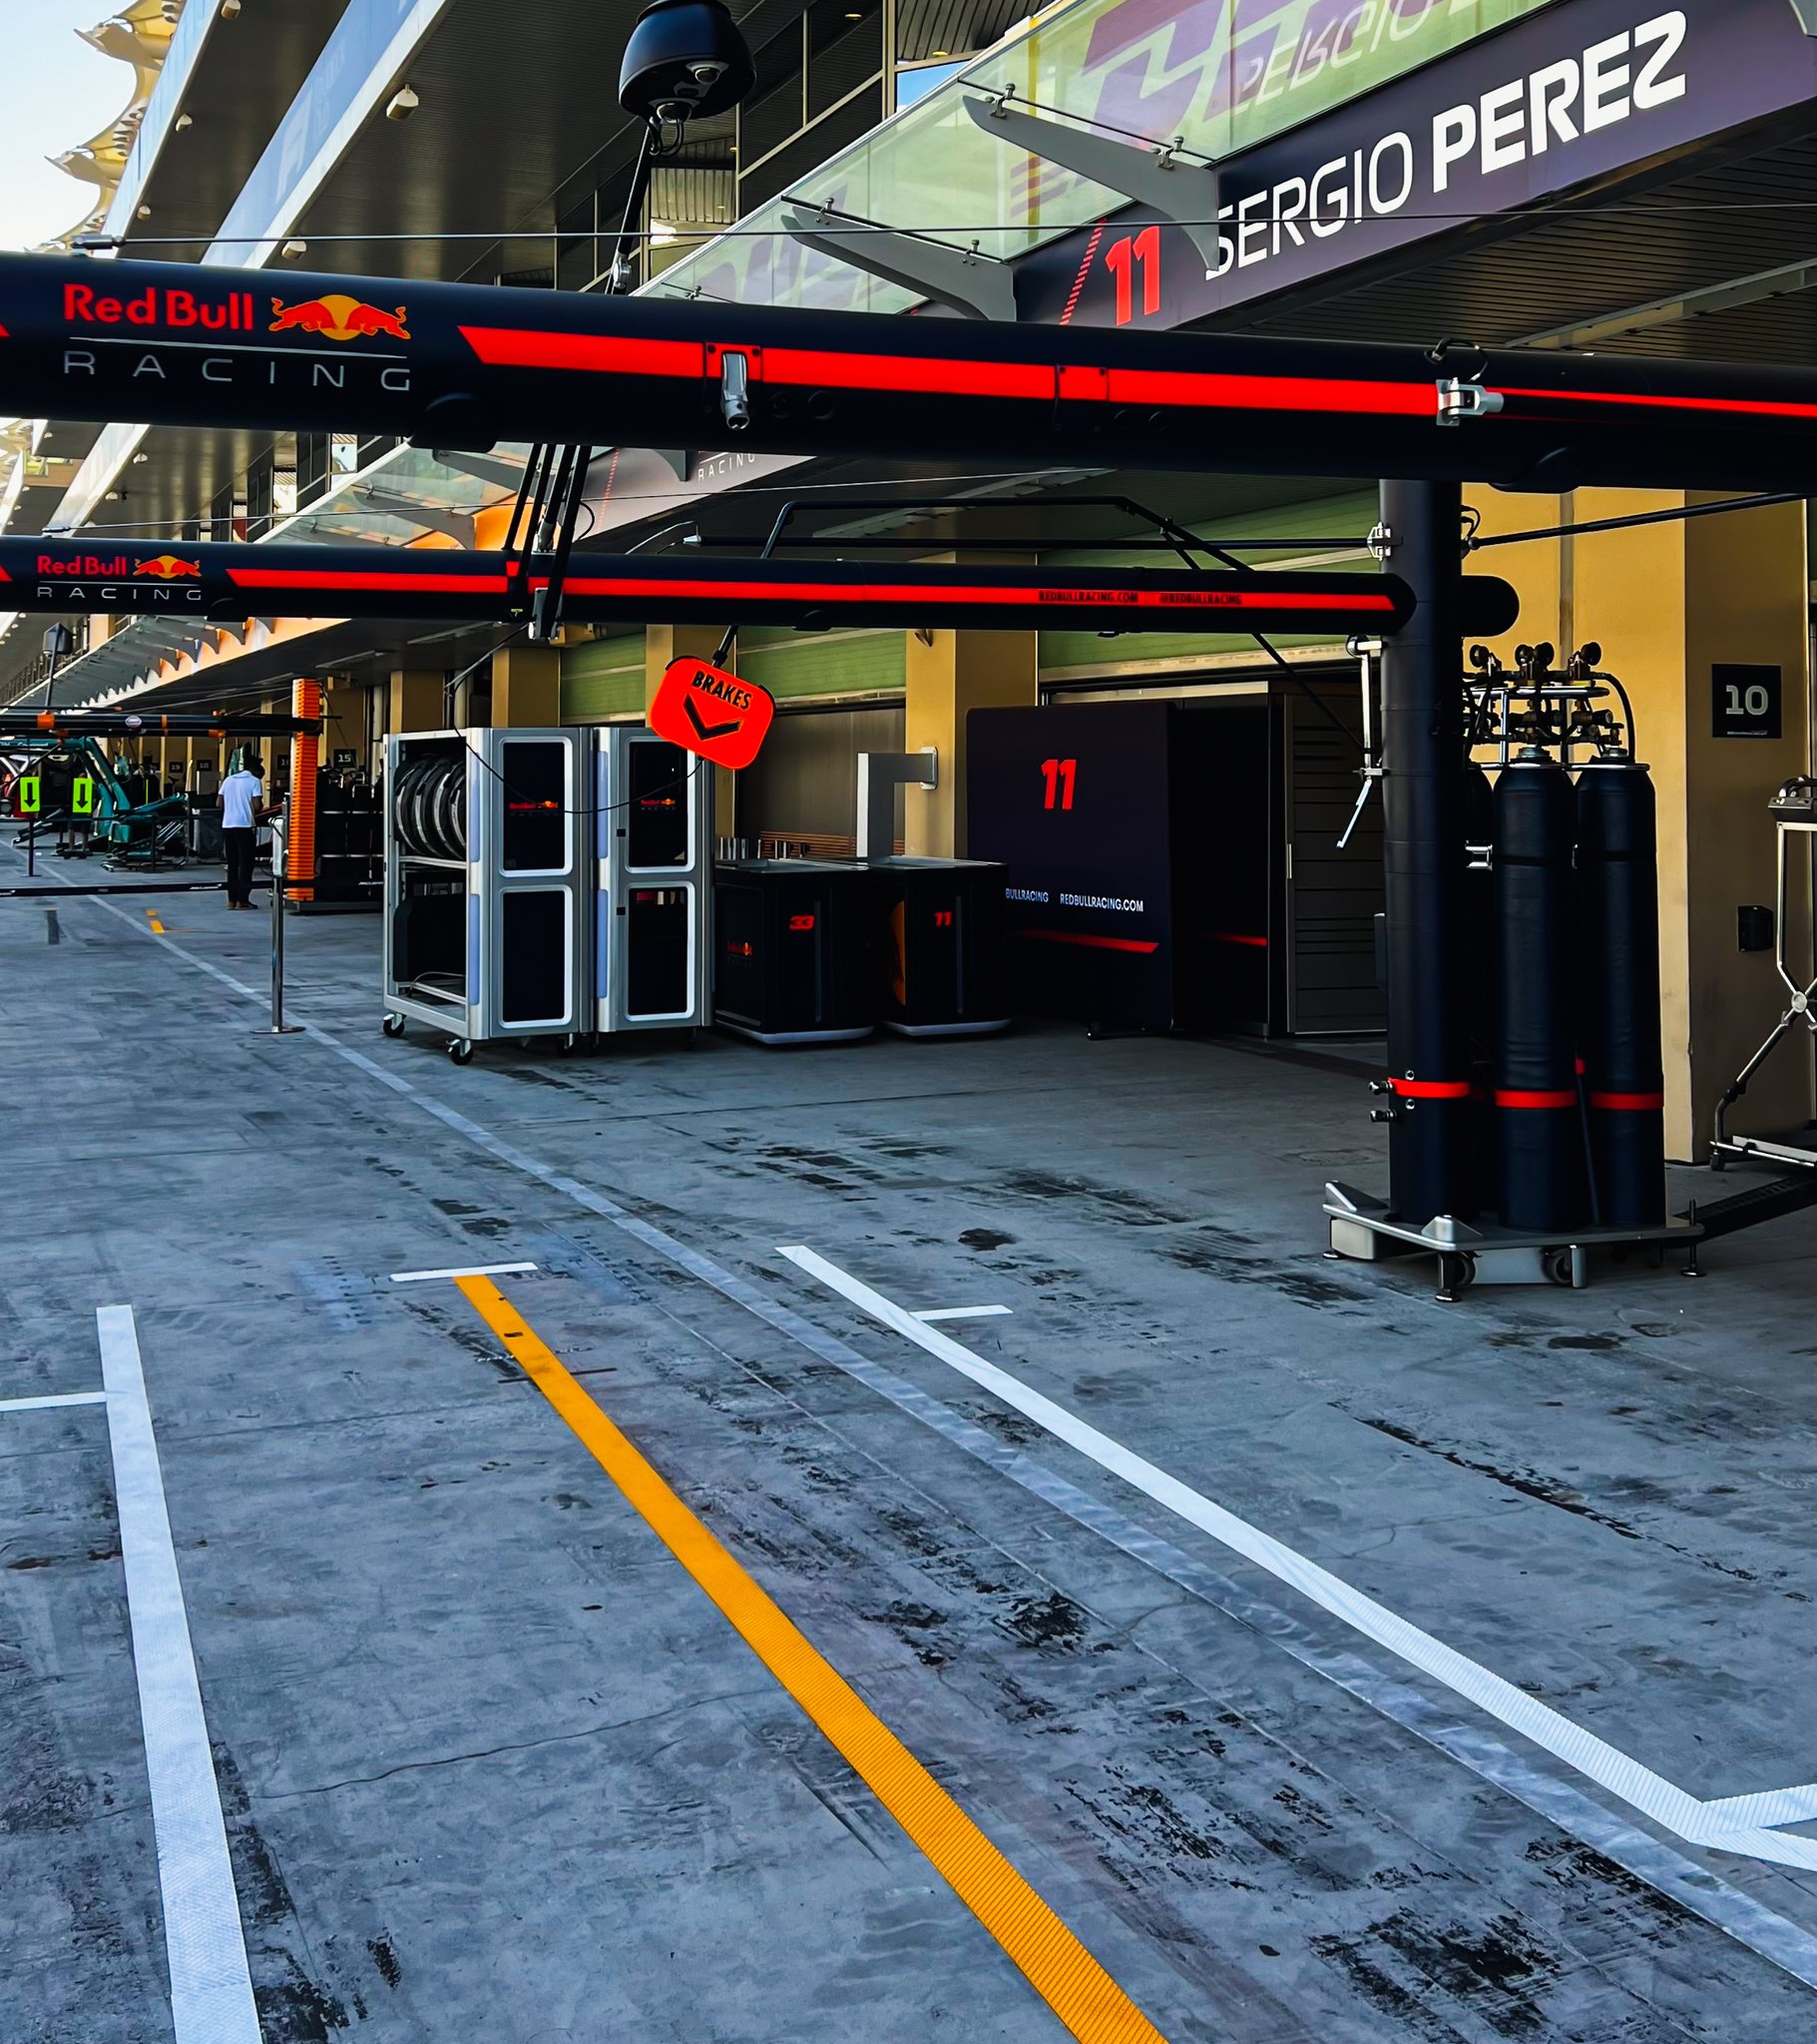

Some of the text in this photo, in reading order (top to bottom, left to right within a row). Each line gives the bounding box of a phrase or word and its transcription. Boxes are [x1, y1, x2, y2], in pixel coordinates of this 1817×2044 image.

[1204, 10, 1686, 281] SERGIO PEREZ
[1106, 226, 1161, 327] 11
[64, 283, 254, 330] Red Bull
[64, 350, 410, 391] RACING
[37, 555, 127, 576] Red Bull
[37, 587, 202, 601] RACING
[692, 671, 752, 710] BRAKES
[1725, 685, 1769, 716] 10
[1041, 760, 1077, 810] 11
[934, 911, 952, 926] 11
[1060, 892, 1144, 912] REDBULLRACING.COM
[789, 914, 815, 930] 33
